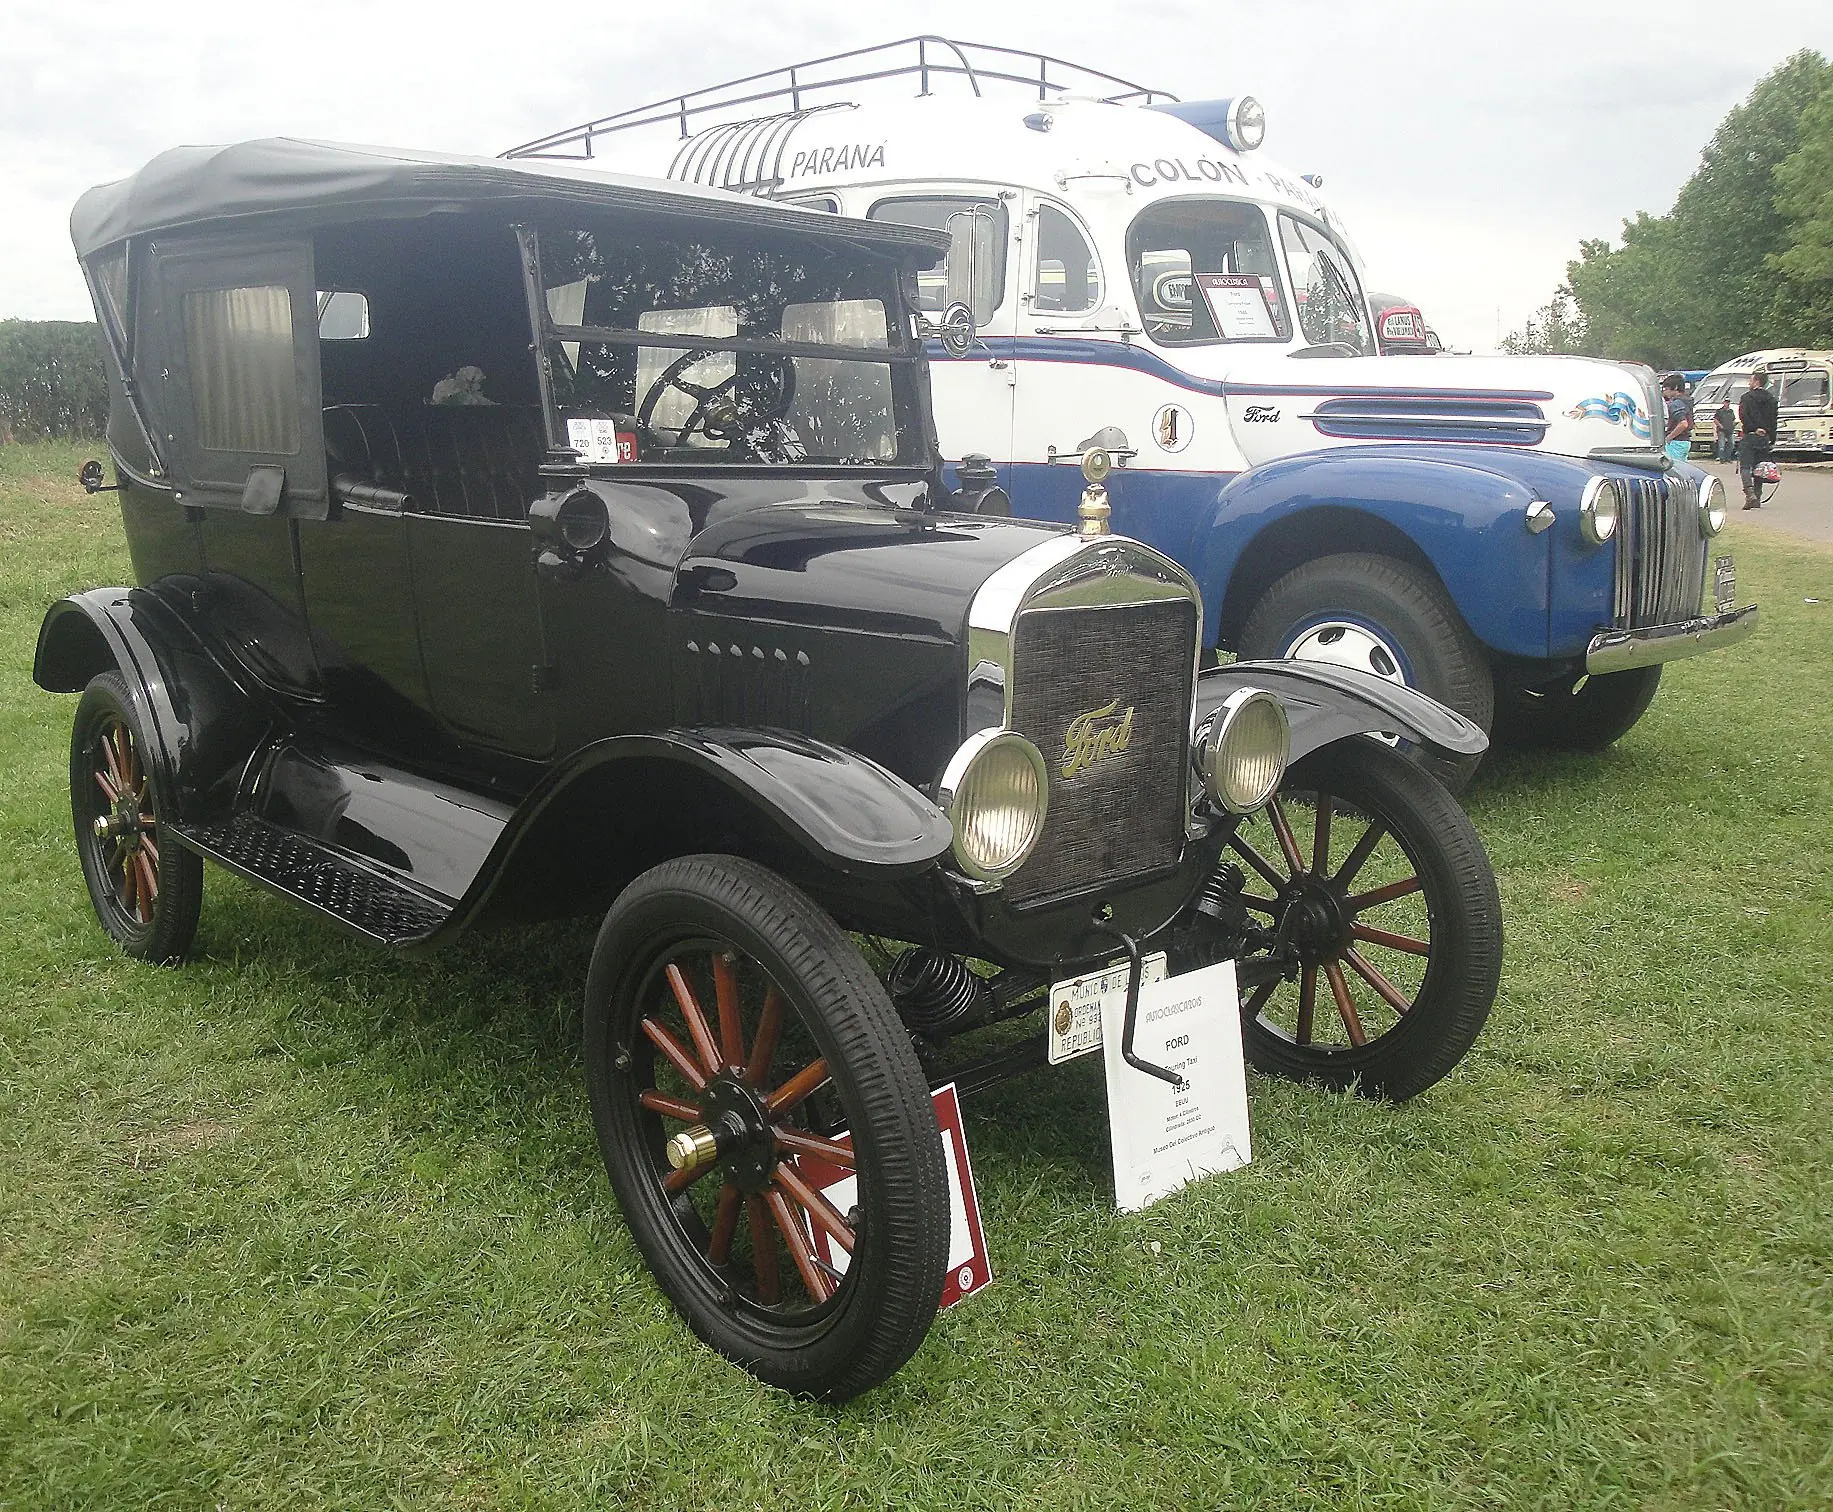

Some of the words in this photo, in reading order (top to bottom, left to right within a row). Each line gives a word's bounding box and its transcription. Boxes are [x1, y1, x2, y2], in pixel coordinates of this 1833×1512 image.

[790, 139, 888, 178] PARANÁ
[1130, 153, 1249, 187] COLÓN
[1243, 405, 1280, 422] Ford
[574, 439, 590, 448] 720
[597, 436, 612, 446] 523
[1061, 699, 1134, 777] Ford
[1112, 974, 1122, 989] DE
[1165, 1034, 1190, 1051] FORD
[1186, 1055, 1198, 1066] Taxi
[1171, 1079, 1190, 1095] 1925
[1175, 1097, 1189, 1108] EEUU
[1153, 1144, 1169, 1154] Museo
